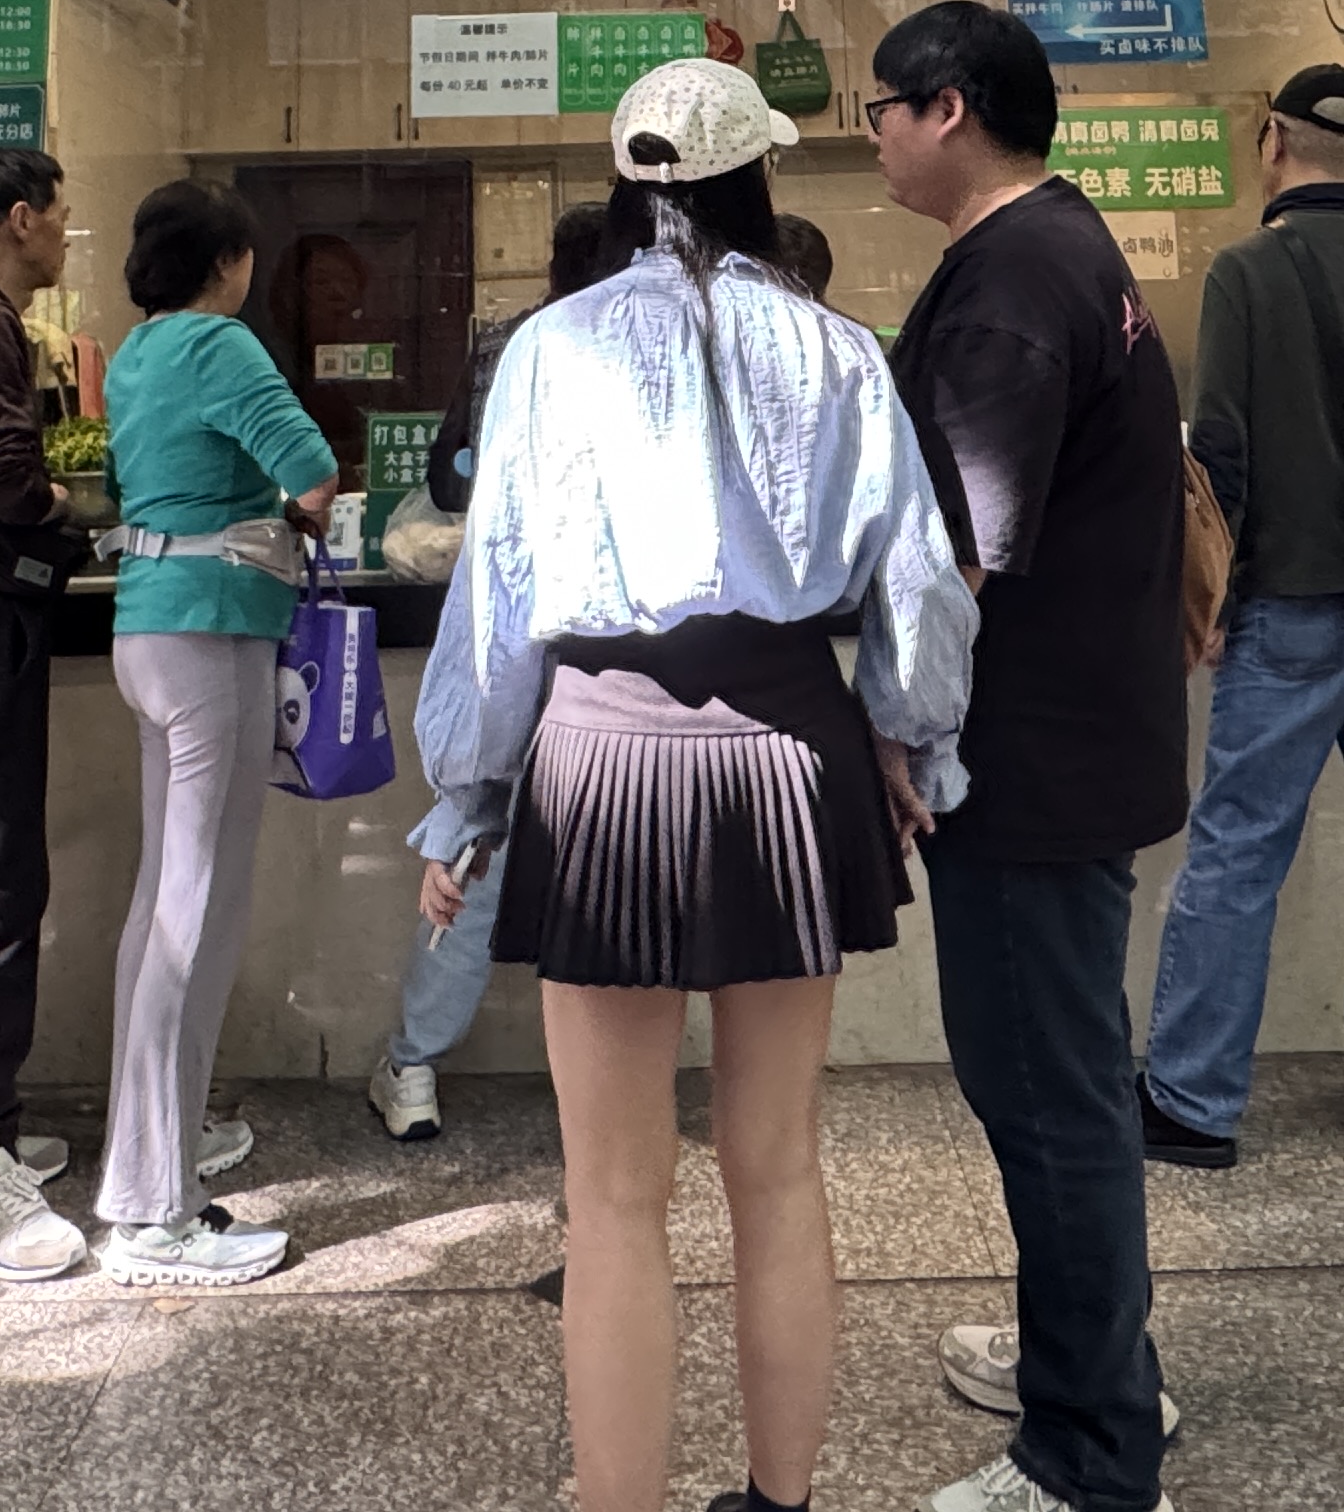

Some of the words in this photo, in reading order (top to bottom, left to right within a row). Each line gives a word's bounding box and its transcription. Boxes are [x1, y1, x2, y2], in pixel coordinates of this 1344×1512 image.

[1100, 36, 1206, 56] 买卤味不排队
[418, 50, 480, 65] 节假日期间
[1138, 118, 1220, 142] 清真卤兔
[1144, 164, 1224, 197] 无硝盐
